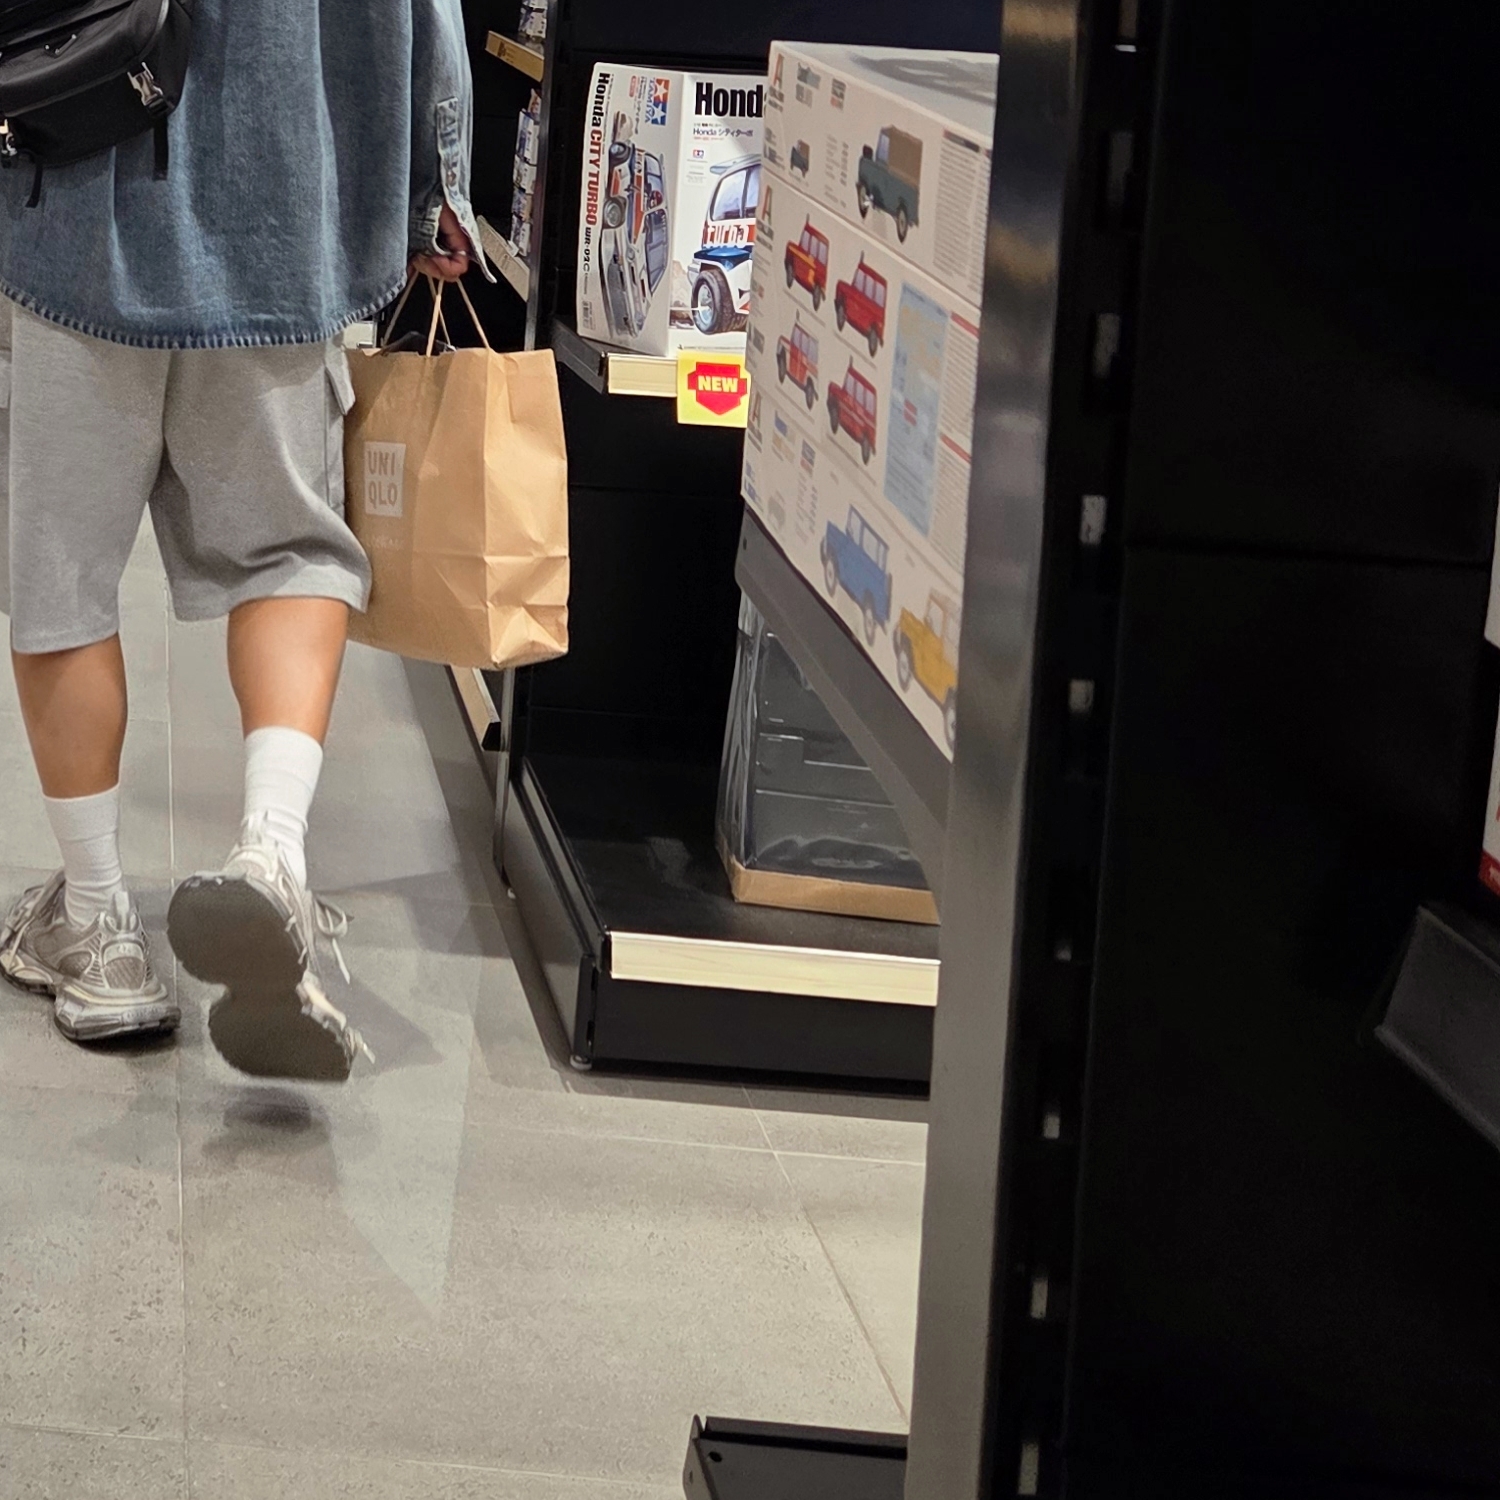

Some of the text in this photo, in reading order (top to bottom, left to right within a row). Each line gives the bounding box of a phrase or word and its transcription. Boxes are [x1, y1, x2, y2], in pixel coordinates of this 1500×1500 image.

[591, 72, 611, 127] Honda
[693, 127, 718, 136] Honda
[589, 129, 604, 170] CITY
[584, 170, 602, 226] TURBO
[697, 375, 739, 393] NEW
[368, 451, 396, 476] UNI
[368, 481, 398, 509] QLO
